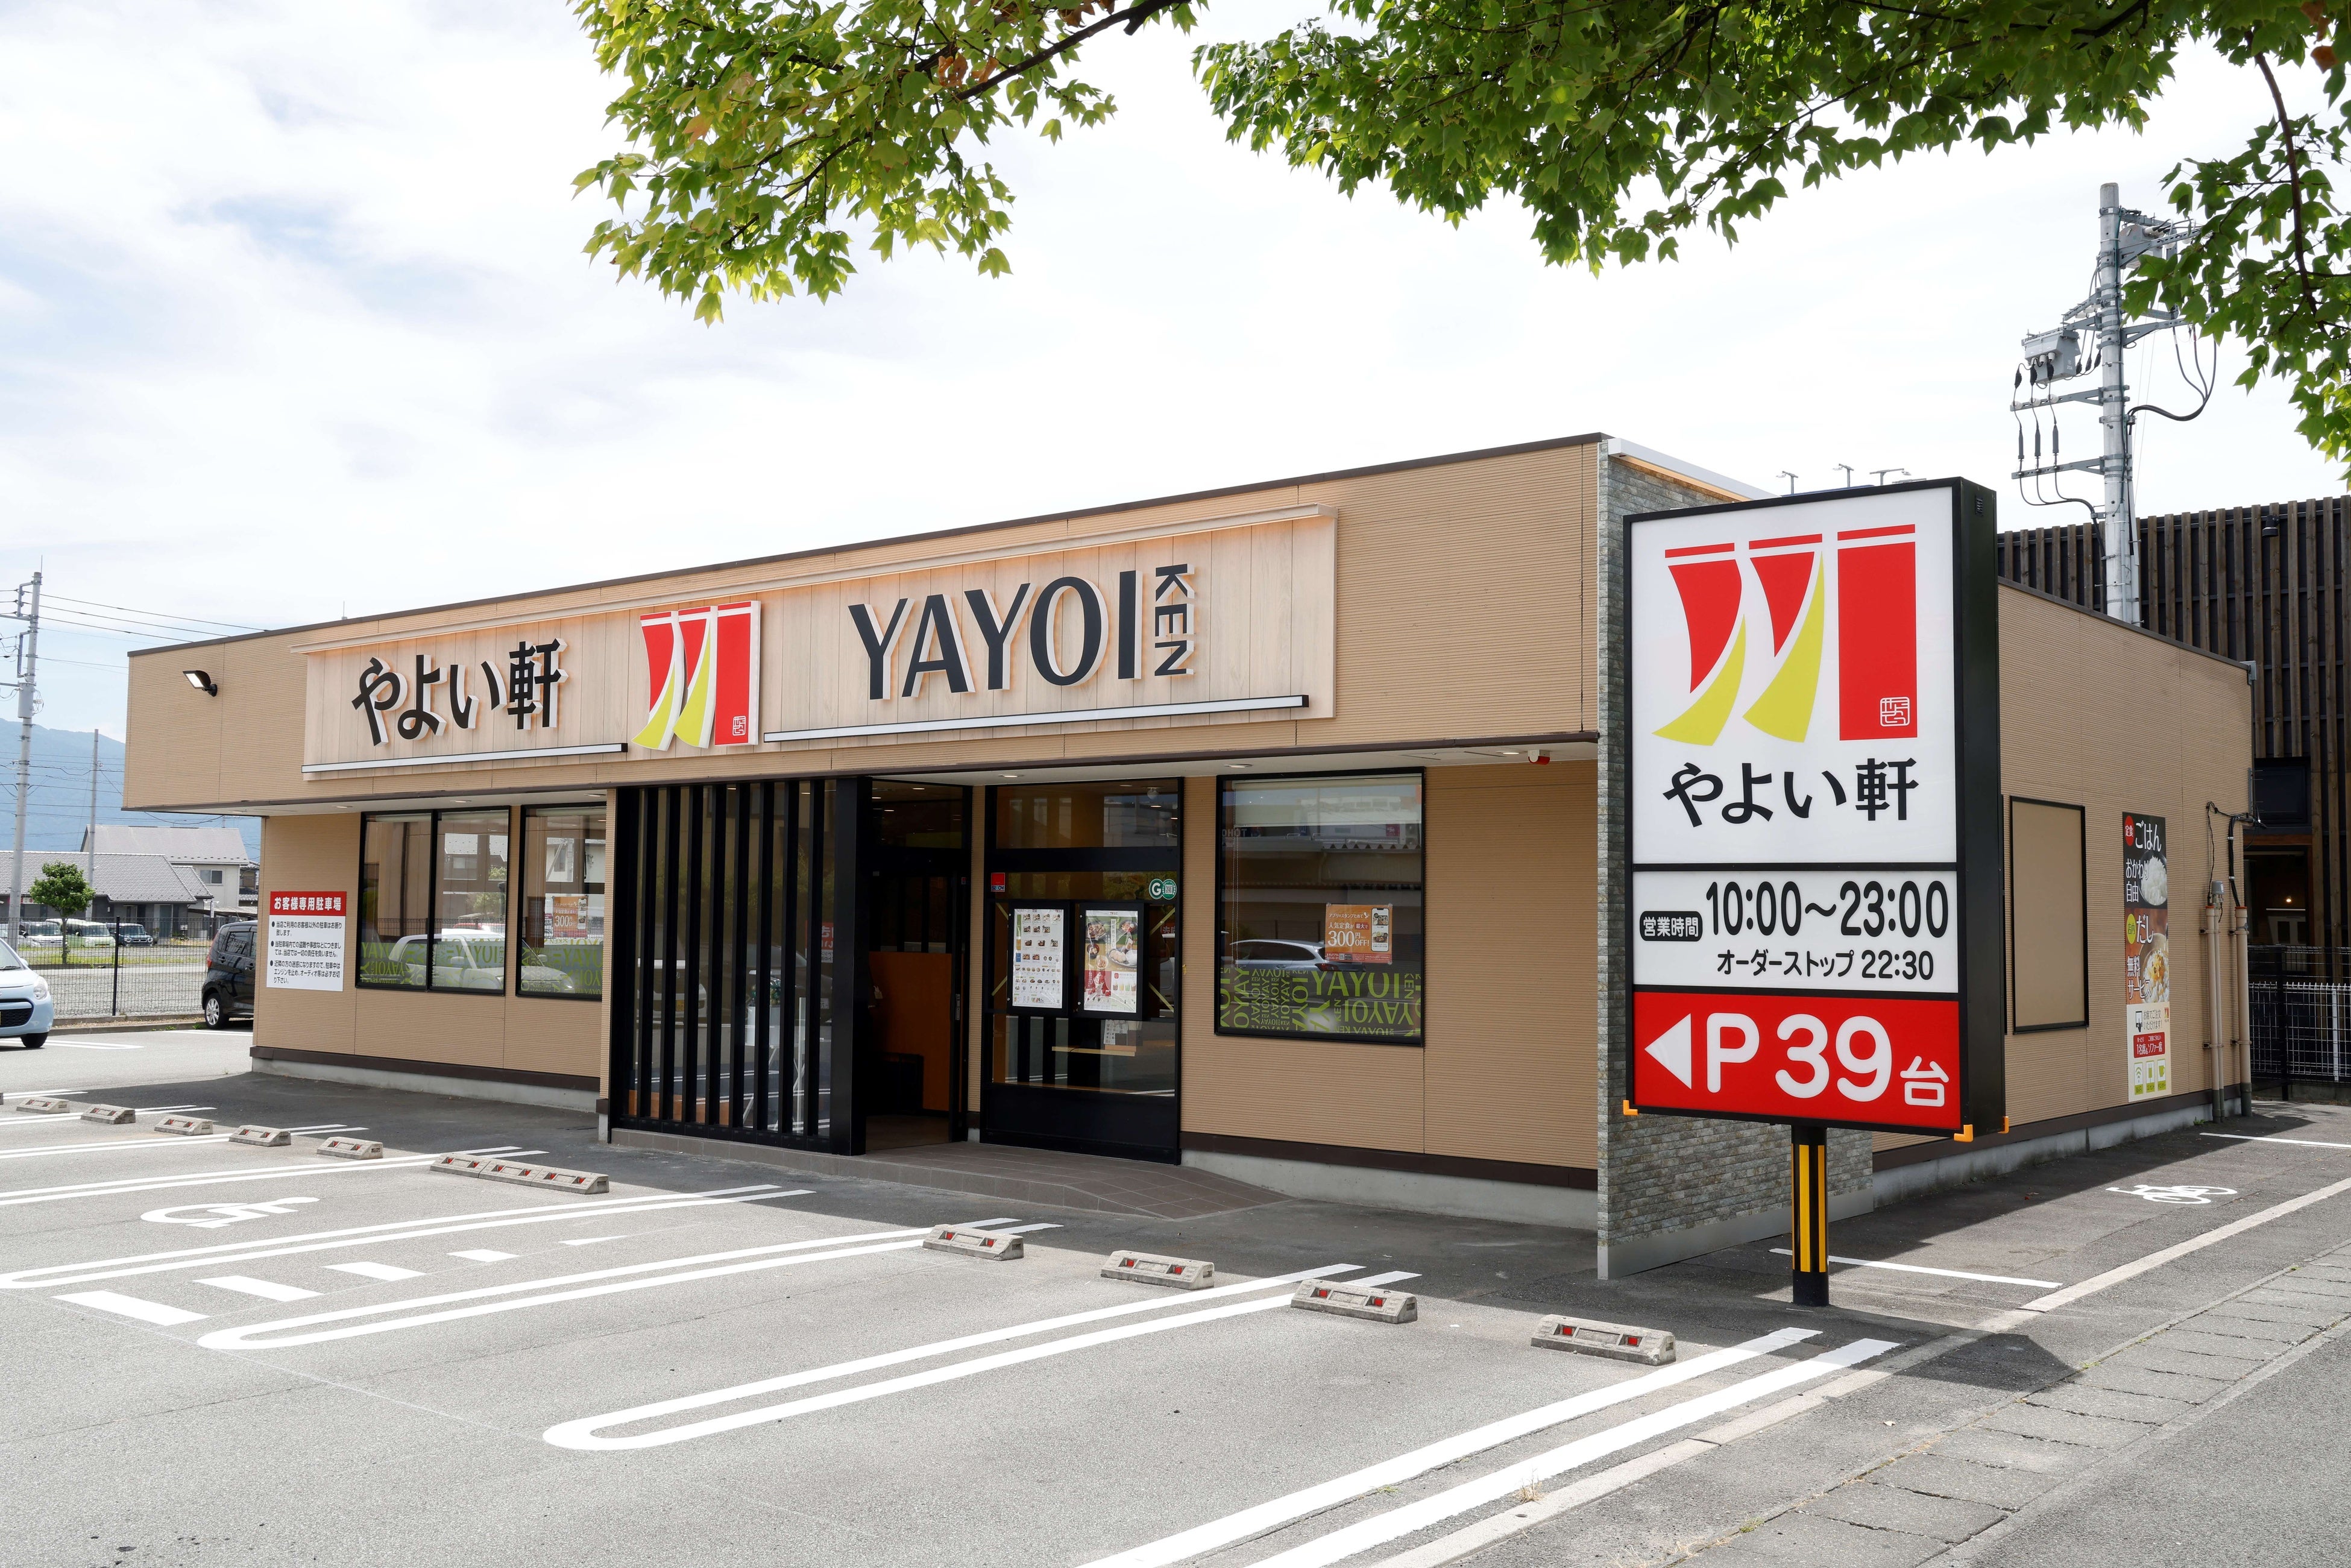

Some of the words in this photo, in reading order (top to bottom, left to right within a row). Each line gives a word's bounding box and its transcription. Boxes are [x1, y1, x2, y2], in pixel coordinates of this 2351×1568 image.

[848, 570, 1142, 701] YAYOI
[1154, 563, 1195, 677] KEN
[351, 637, 568, 748] やよい軒
[1663, 758, 1919, 828] やよい軒
[2125, 825, 2133, 837] 定食
[2135, 820, 2162, 852] ごはん
[2126, 858, 2150, 880] おかわり
[274, 896, 342, 911] お客様専用駐車場
[2126, 881, 2139, 902] 自由
[555, 915, 569, 927] 300
[1643, 916, 1699, 938] 営業時間
[2136, 914, 2154, 944] だし
[1327, 930, 1355, 946] 300
[1717, 949, 1855, 977] オーダーストップ
[1861, 949, 1934, 980] 22:30
[2127, 956, 2141, 977] 無料
[1311, 971, 1399, 999] YAYOI
[2127, 978, 2151, 1000] サービス
[1706, 1012, 1760, 1093] P
